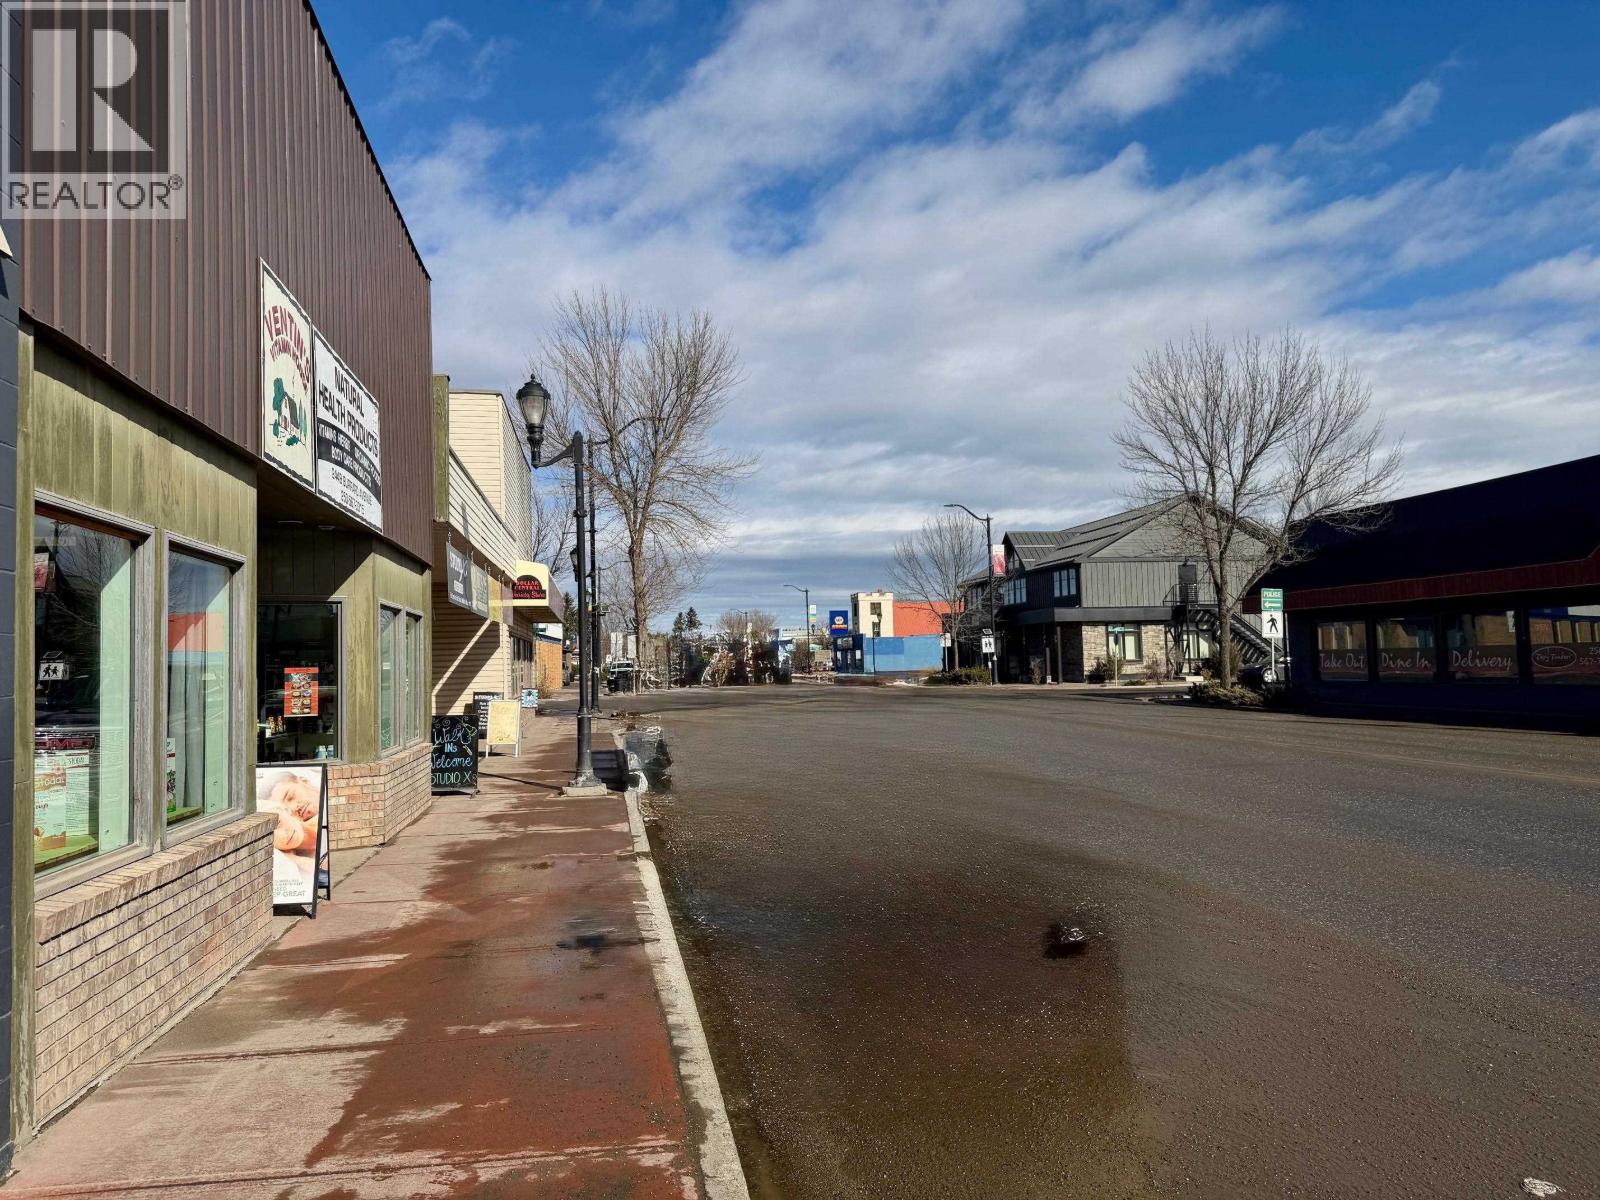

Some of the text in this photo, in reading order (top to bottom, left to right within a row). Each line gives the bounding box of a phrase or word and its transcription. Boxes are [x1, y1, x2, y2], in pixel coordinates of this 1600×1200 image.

[335, 366, 365, 418] NATURAL
[319, 379, 378, 458] HEALTH PRODUCTS
[1319, 652, 1364, 669] Take Out
[1382, 651, 1432, 668] Dine In
[1452, 649, 1513, 672] Delivery
[463, 771, 472, 783] X
